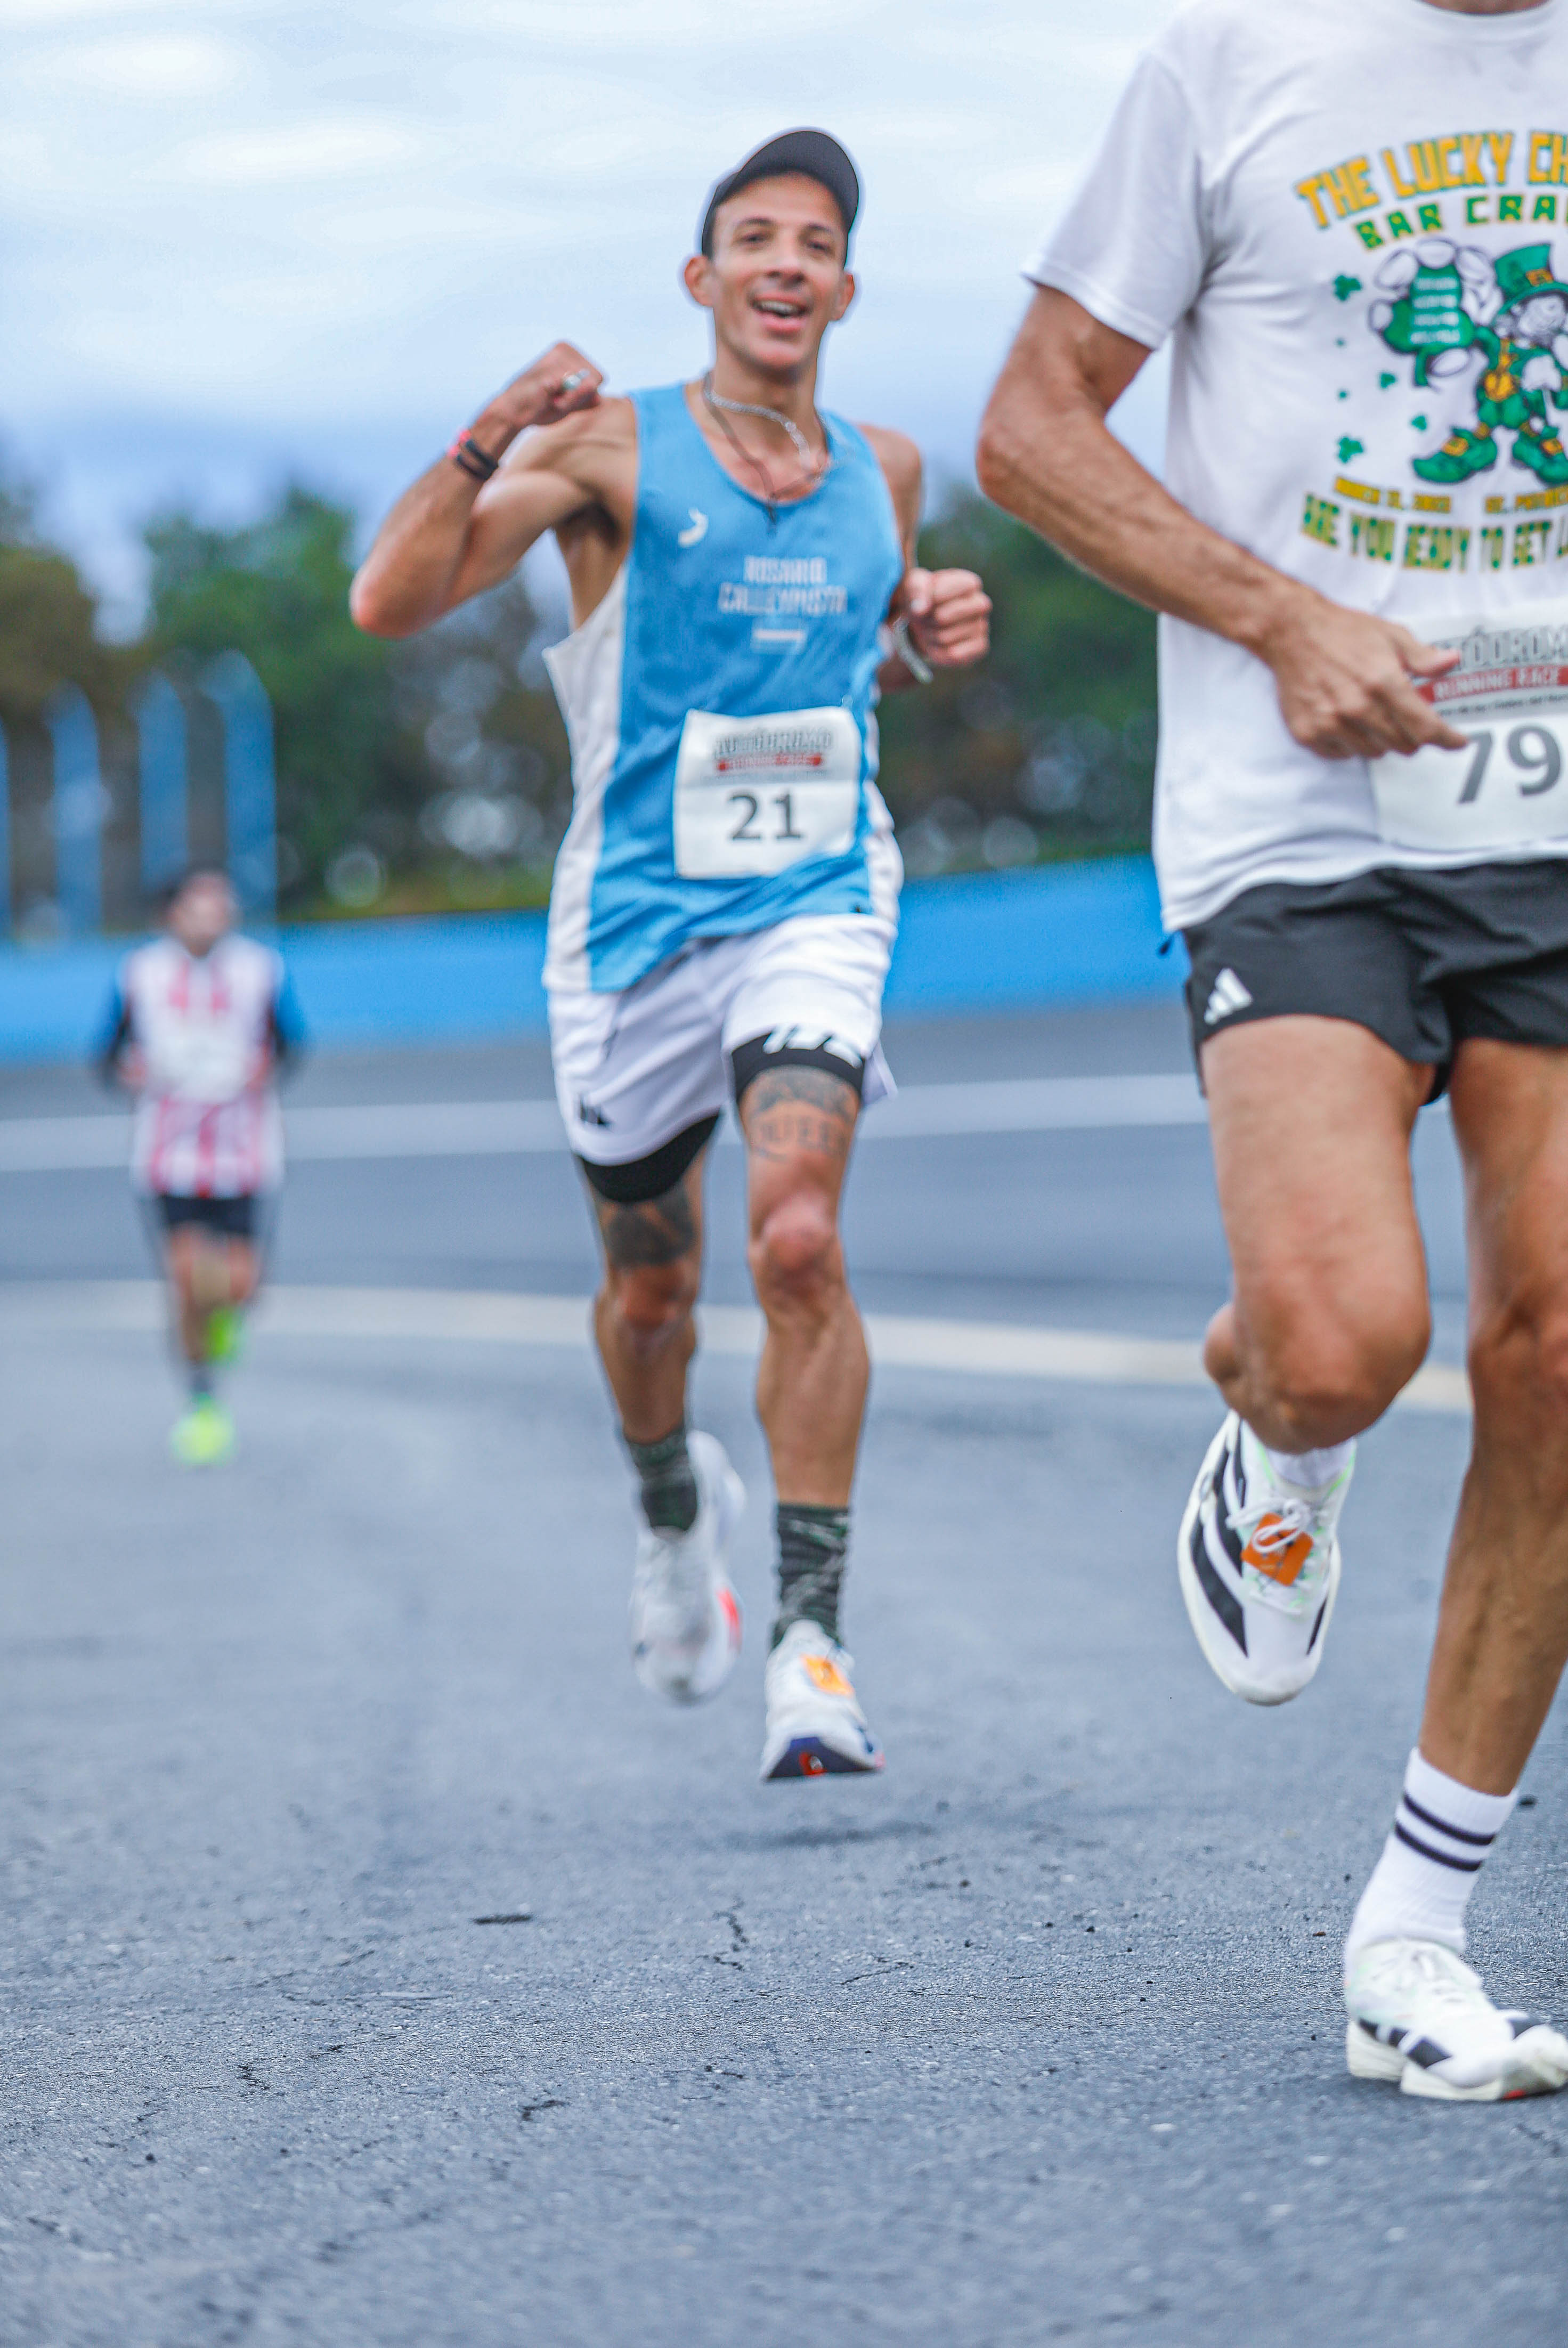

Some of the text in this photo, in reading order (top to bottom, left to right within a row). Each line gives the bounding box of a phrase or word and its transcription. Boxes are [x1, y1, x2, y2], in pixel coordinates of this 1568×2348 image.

[1296, 156, 1380, 228] THE
[1381, 132, 1515, 198] LUCKY
[1353, 194, 1568, 251] BAR CRA
[1458, 725, 1561, 803] 79
[729, 793, 803, 840] 21
